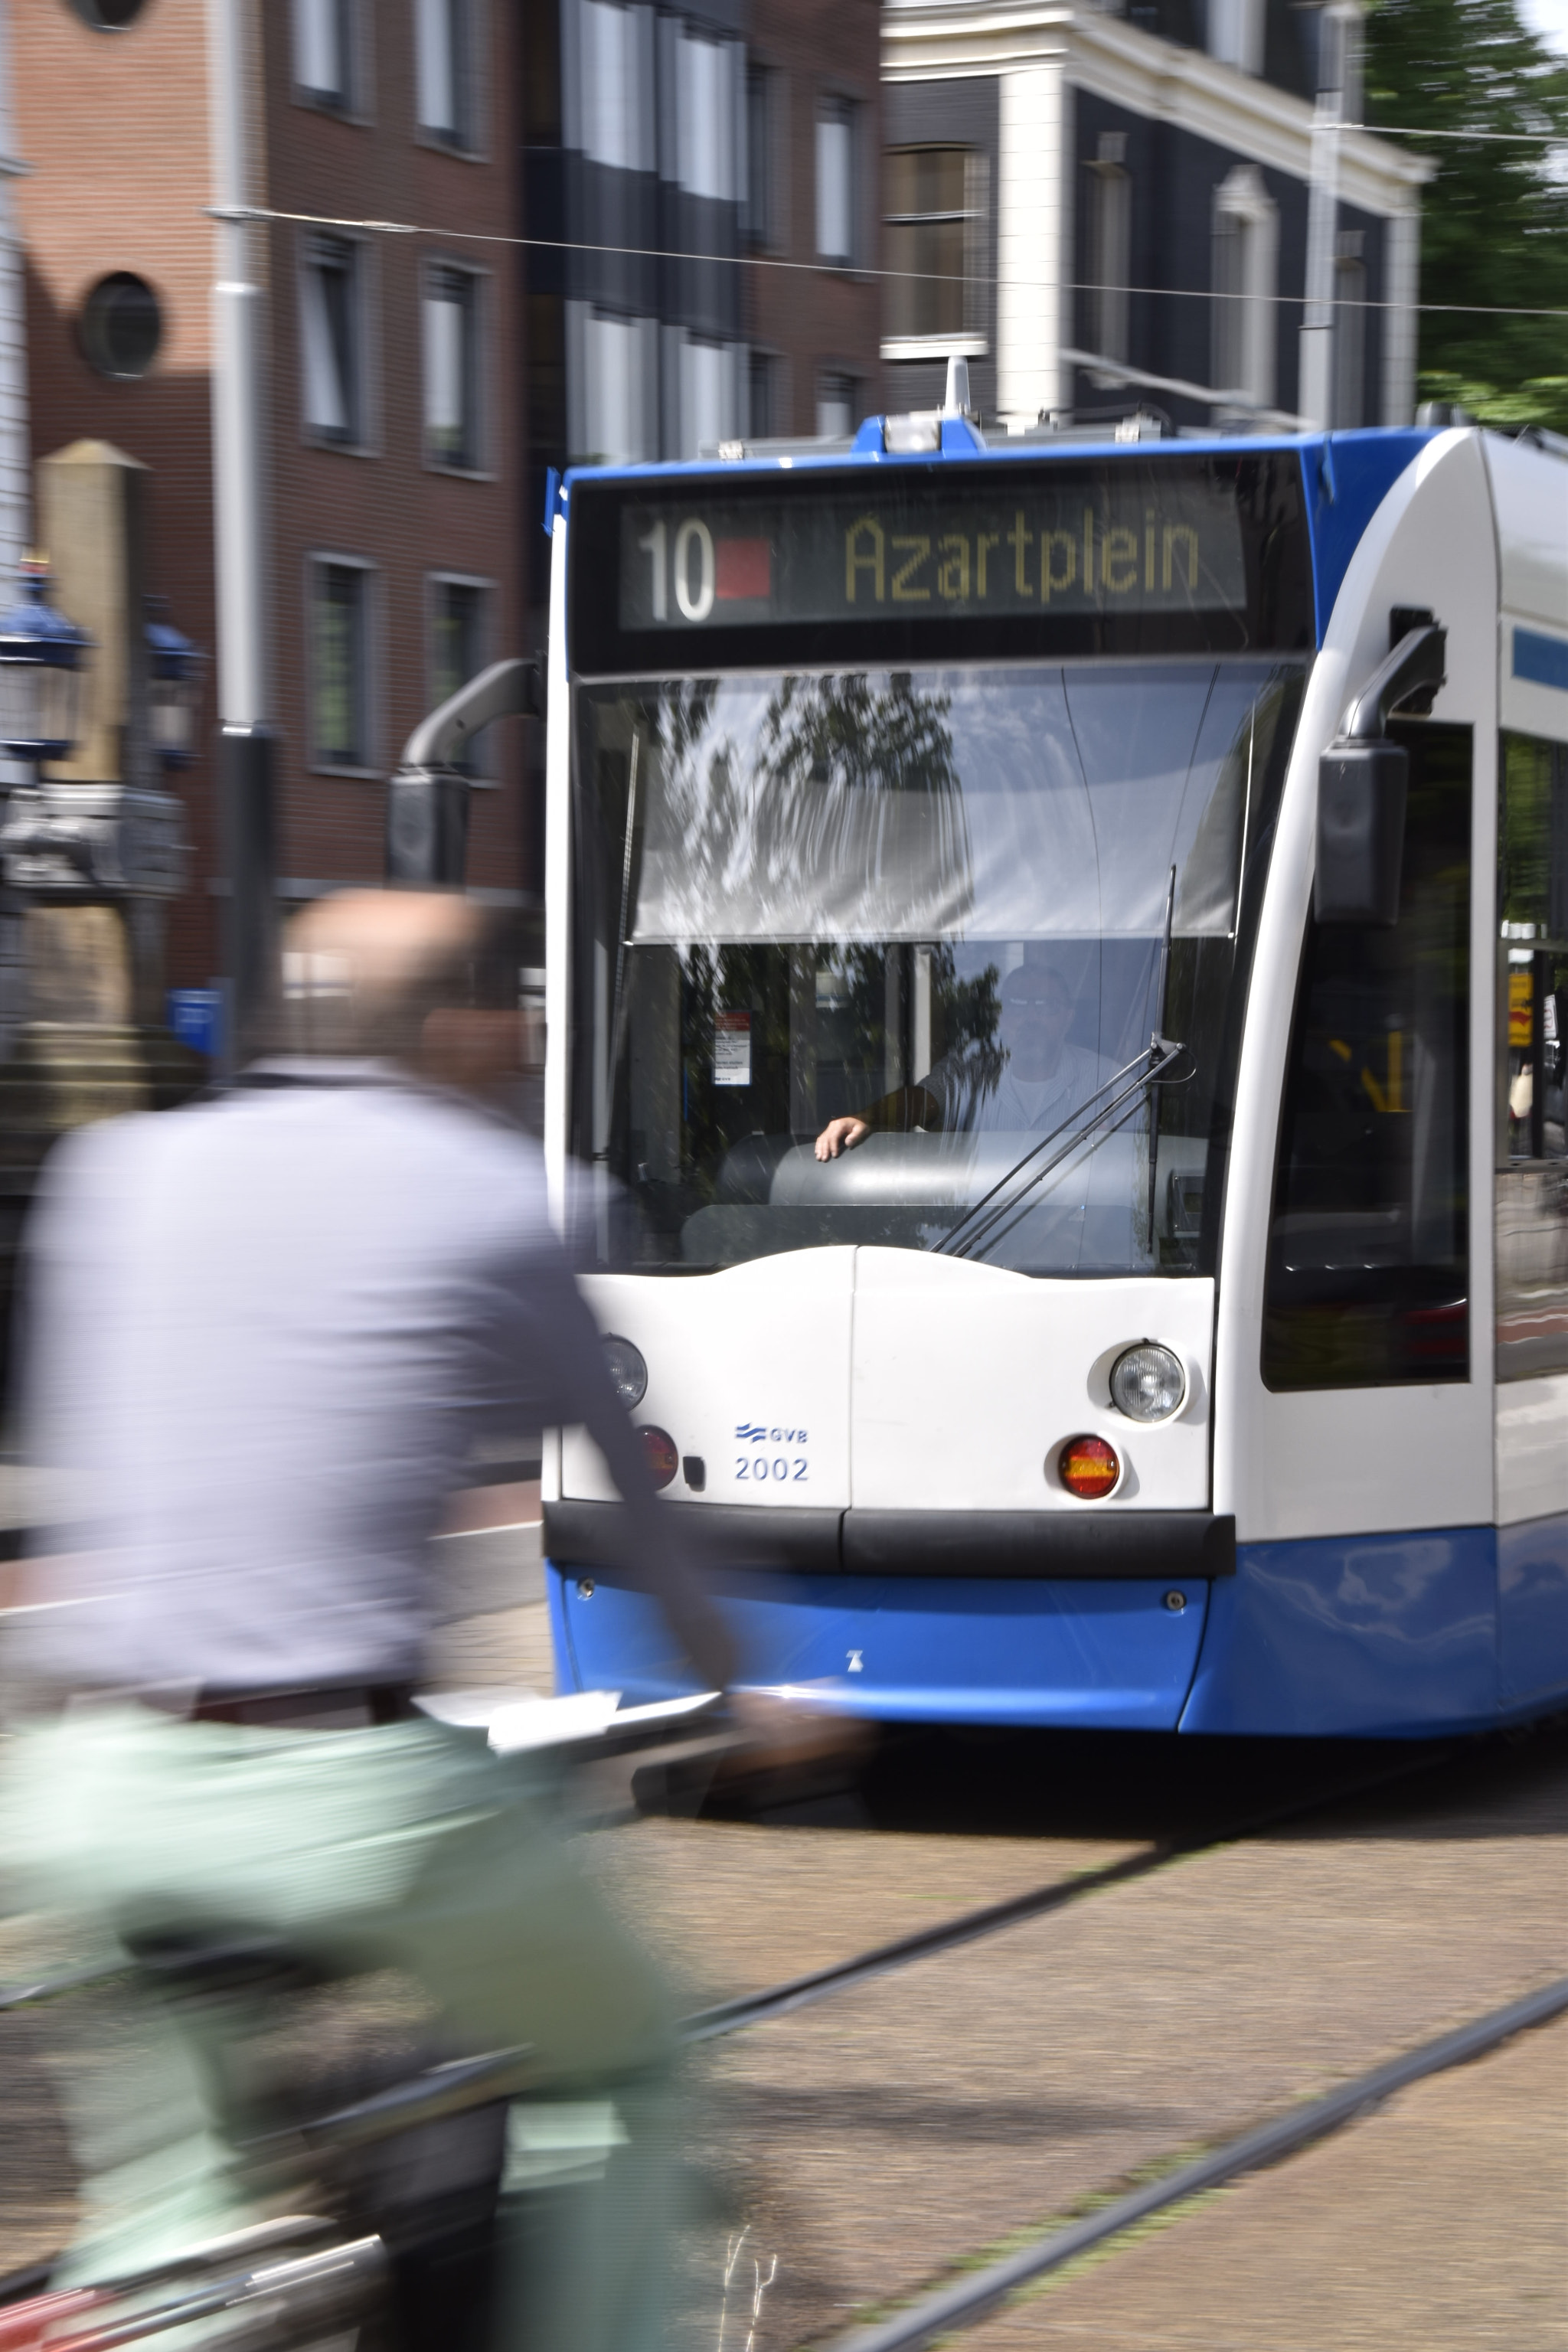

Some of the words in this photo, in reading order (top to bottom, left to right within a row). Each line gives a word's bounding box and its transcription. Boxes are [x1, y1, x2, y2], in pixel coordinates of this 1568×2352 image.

[639, 518, 714, 622] 10
[846, 508, 1199, 604] Azartplein
[770, 1428, 808, 1443] GVB
[735, 1457, 808, 1481] 2002
